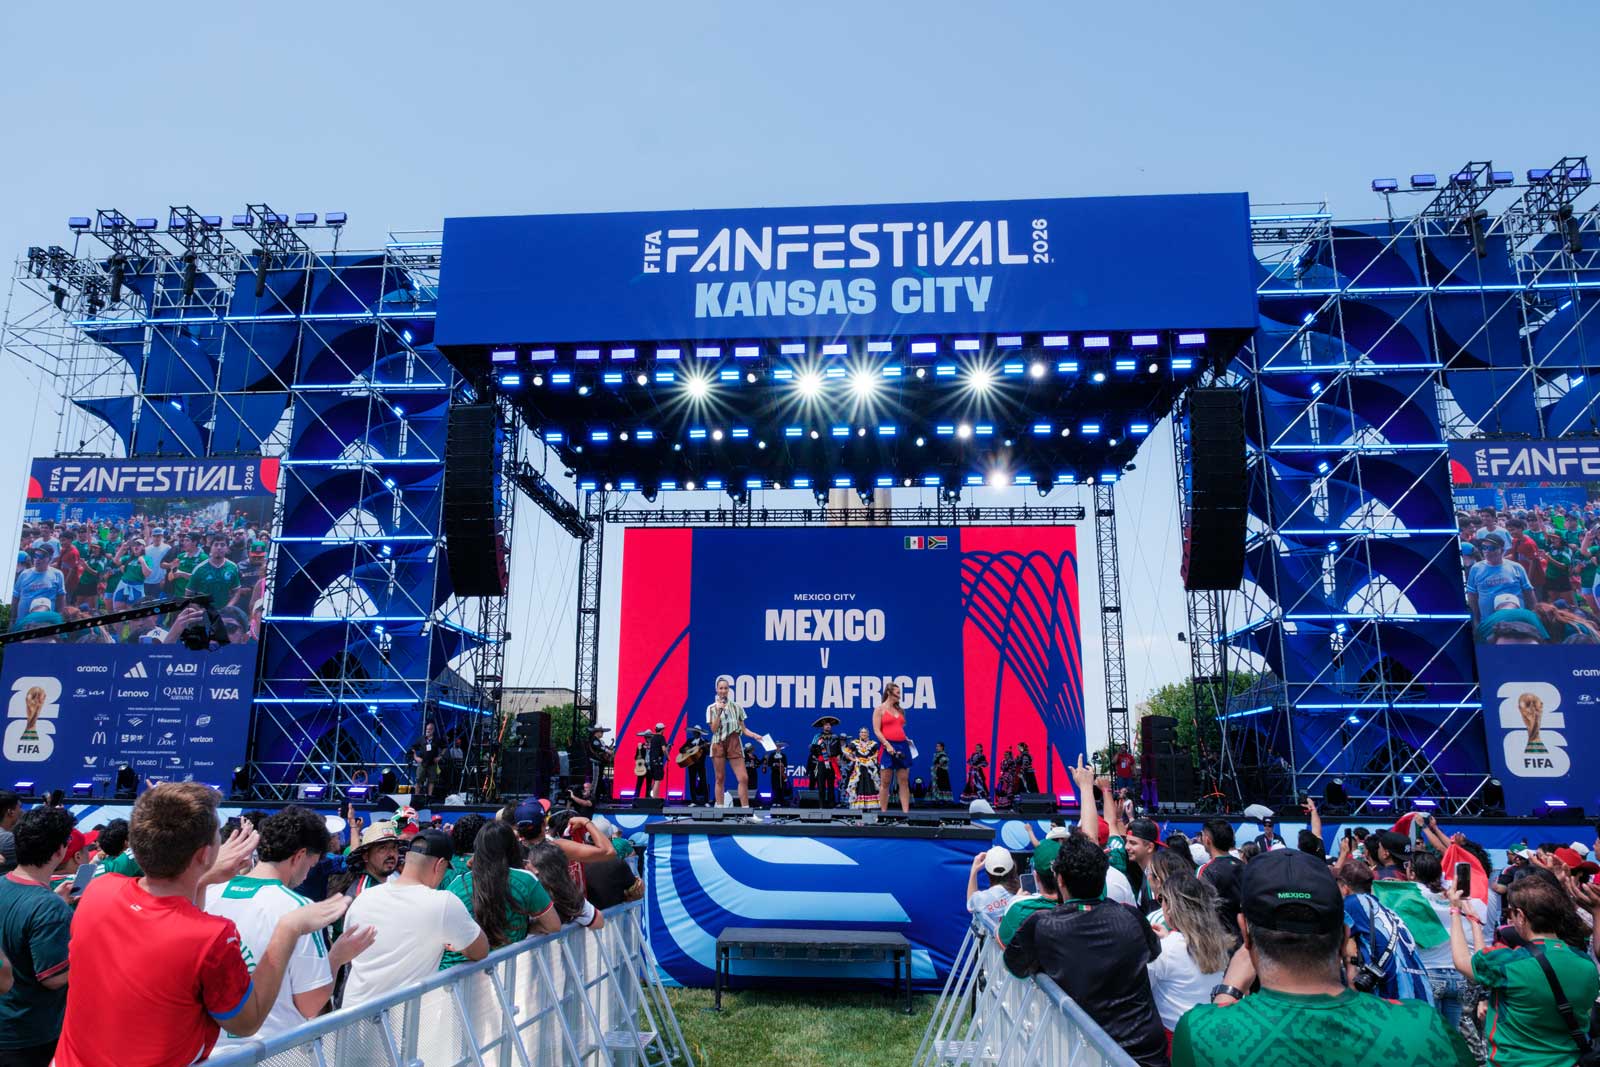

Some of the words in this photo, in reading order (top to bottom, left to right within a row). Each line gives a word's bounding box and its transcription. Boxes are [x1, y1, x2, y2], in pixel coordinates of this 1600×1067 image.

[644, 230, 661, 274] FIFA
[1032, 218, 1050, 264] 2026
[694, 276, 878, 318] KANSAS
[891, 275, 993, 315] CITY
[1475, 448, 1488, 476] FIFA
[49, 466, 62, 492] FIFA
[793, 593, 832, 601] MEXICO
[833, 593, 856, 601] CITY
[765, 608, 886, 642] MEXICO
[76, 664, 108, 673] aramco
[174, 663, 198, 673] ADI
[117, 689, 150, 698] Lenovo
[163, 687, 195, 697] QATAR
[209, 688, 240, 700] VISA
[16, 744, 40, 754] FIFA
[1524, 758, 1554, 769] FIFA
[1277, 891, 1312, 899] MEXICO
